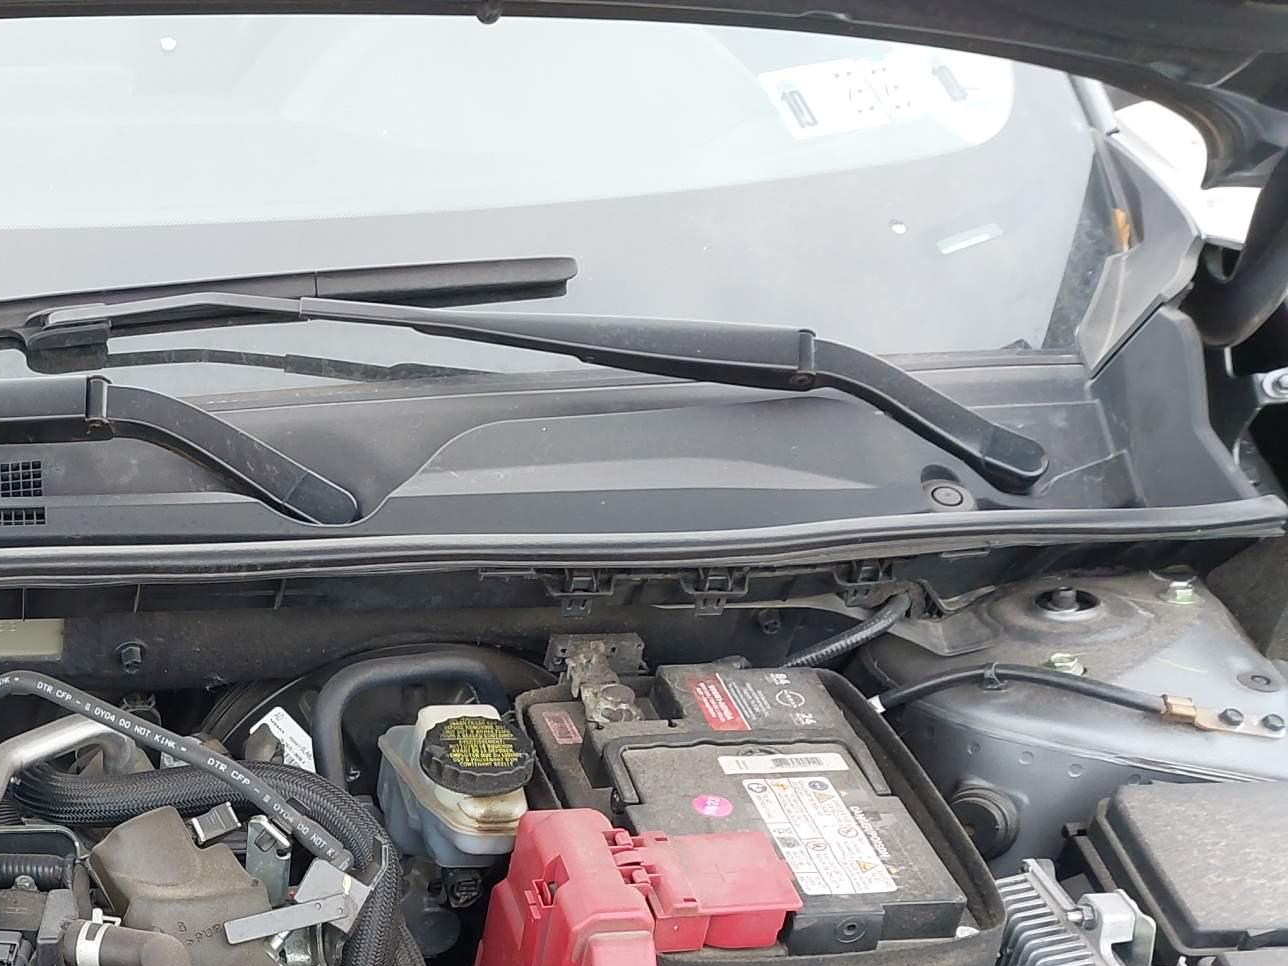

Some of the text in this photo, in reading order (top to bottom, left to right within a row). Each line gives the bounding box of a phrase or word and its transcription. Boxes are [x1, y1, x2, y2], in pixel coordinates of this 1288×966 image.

[37, 681, 54, 694] DTR
[56, 689, 72, 701] CFP
[119, 718, 131, 729] DO
[134, 725, 151, 737] NOT
[154, 733, 176, 750] KINK
[207, 757, 227, 772] DTR
[231, 770, 251, 785] CFP
[296, 822, 309, 835] DO
[311, 833, 328, 849] NOT
